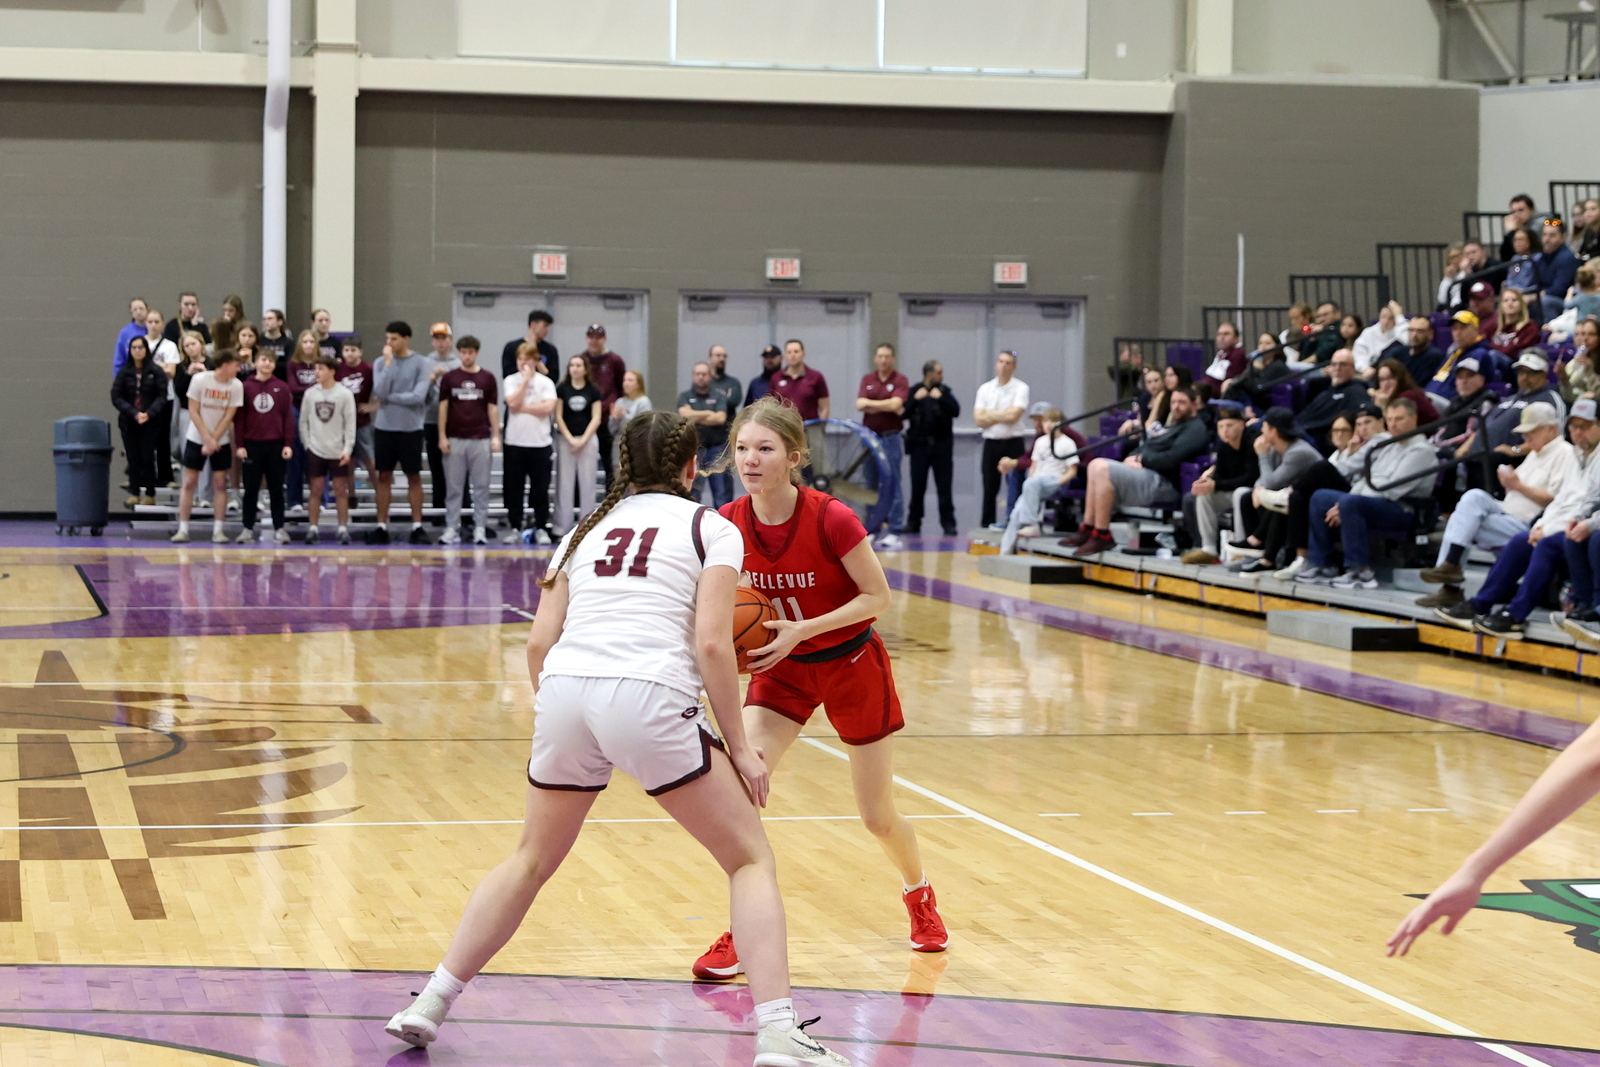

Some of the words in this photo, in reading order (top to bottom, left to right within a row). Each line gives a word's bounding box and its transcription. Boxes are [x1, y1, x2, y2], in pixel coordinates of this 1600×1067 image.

[540, 254, 561, 271] EXIT
[594, 527, 659, 577] 31
[771, 596, 804, 622] 11
